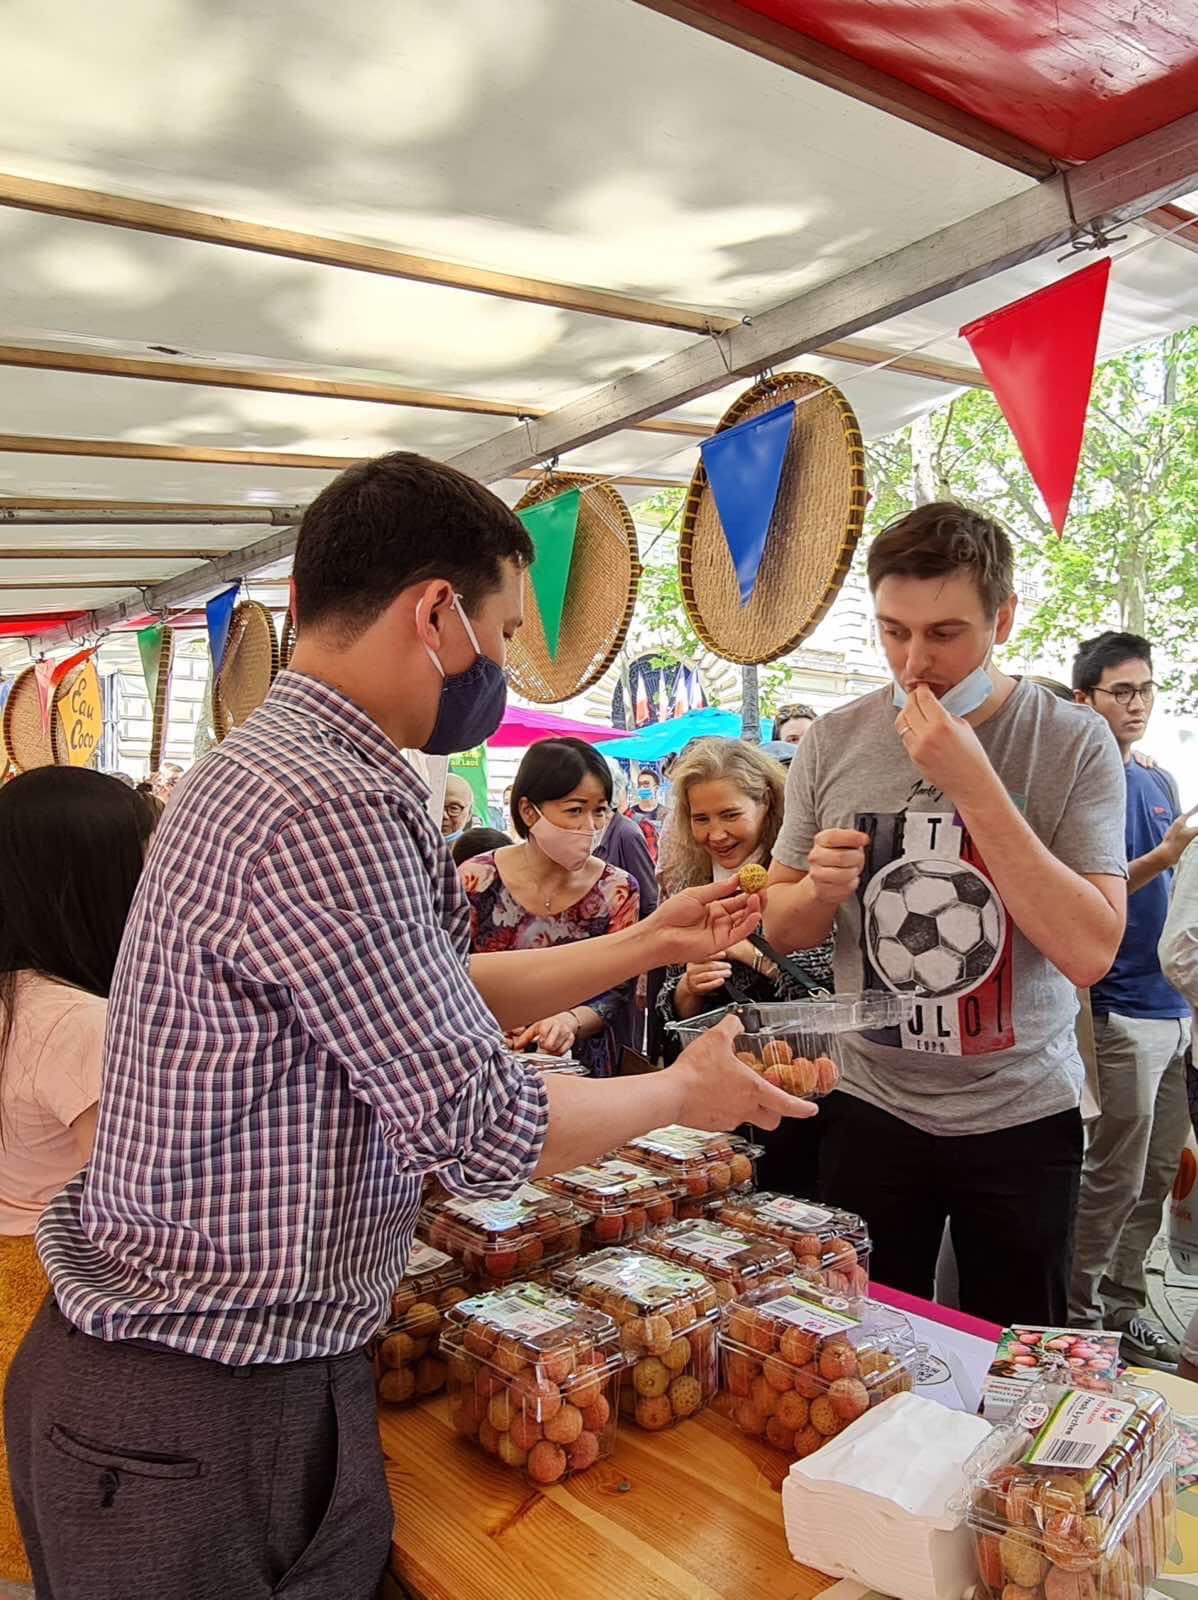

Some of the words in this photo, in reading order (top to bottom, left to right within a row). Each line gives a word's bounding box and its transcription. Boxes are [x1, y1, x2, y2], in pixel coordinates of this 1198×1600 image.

[71, 678, 94, 720] Eau
[71, 719, 94, 750] Coco
[1078, 1395, 1096, 1415] Fresh
[1065, 1410, 1086, 1435] Lychee
